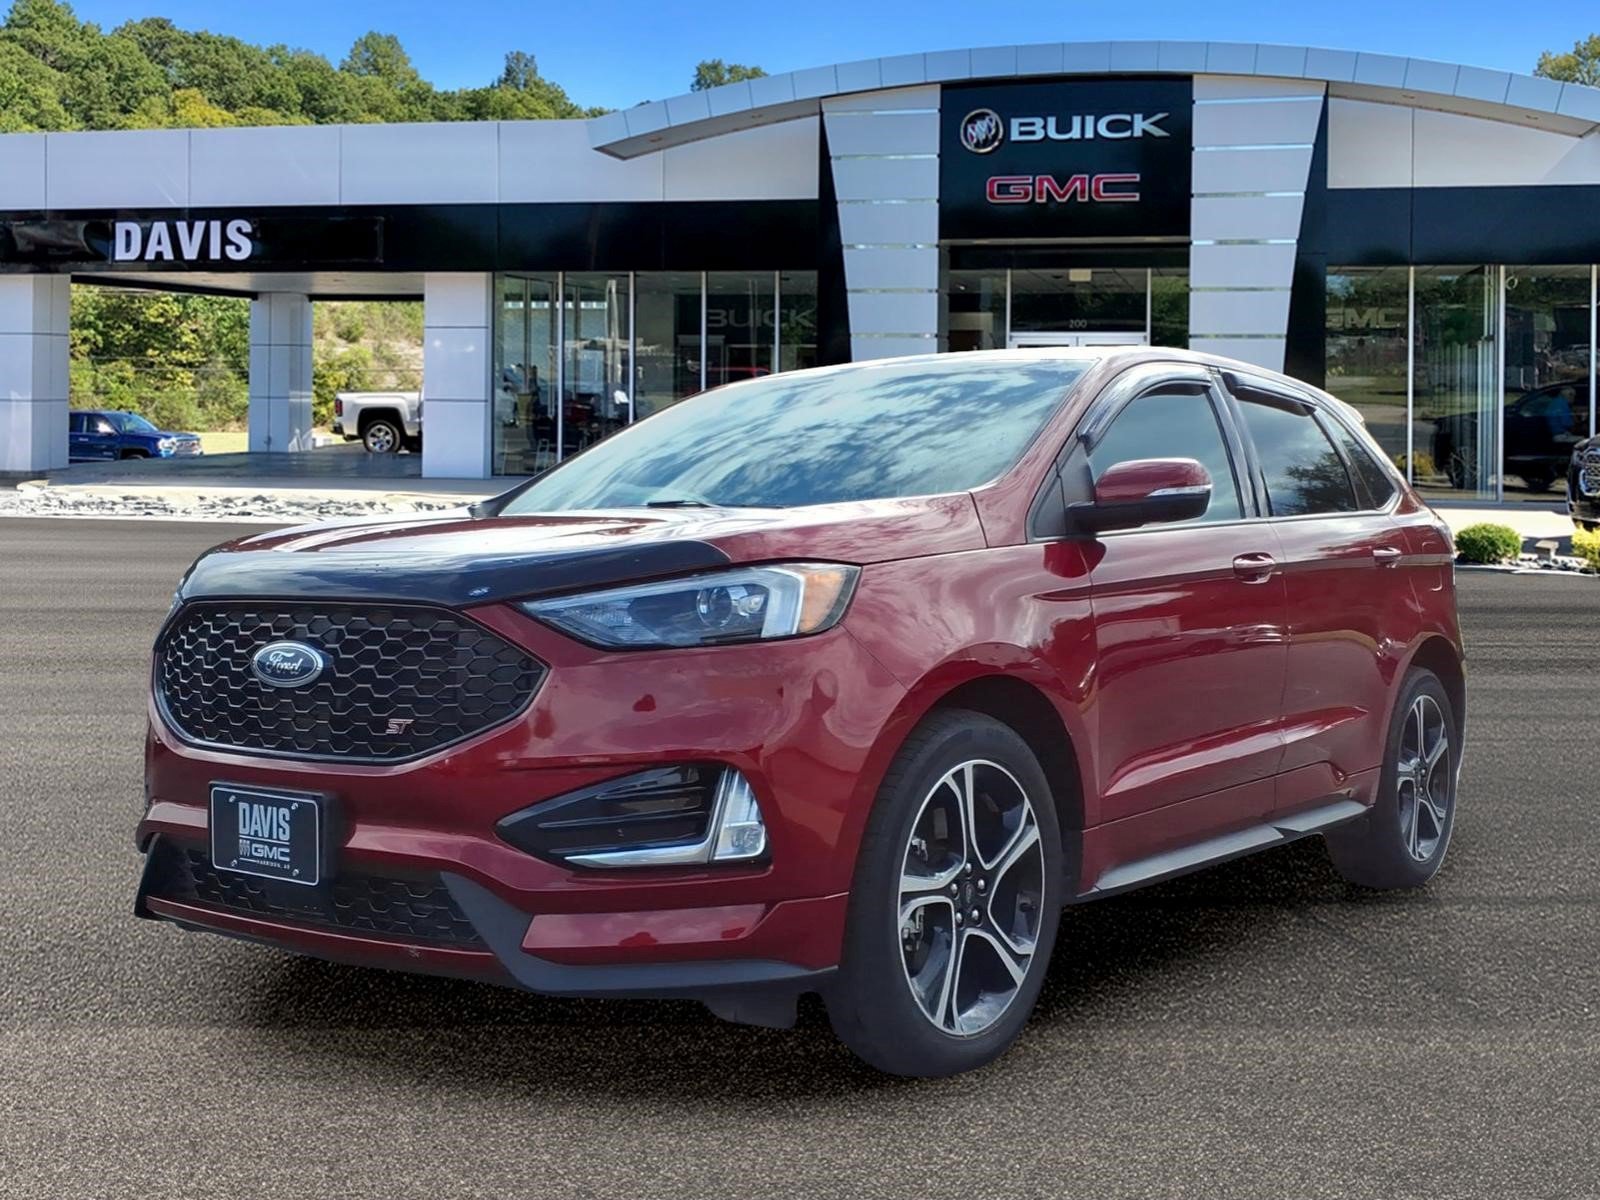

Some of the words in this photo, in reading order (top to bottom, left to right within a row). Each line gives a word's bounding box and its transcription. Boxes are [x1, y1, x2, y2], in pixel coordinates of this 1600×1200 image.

[1009, 112, 1171, 142] BUICK
[985, 173, 1141, 204] GMC
[113, 219, 254, 262] DAVIS
[706, 308, 816, 328] BUICK
[1068, 319, 1088, 329] 200
[267, 650, 303, 673] Ford
[385, 718, 414, 735] ST
[237, 802, 291, 842] DAVIS
[251, 843, 291, 862] GMC
